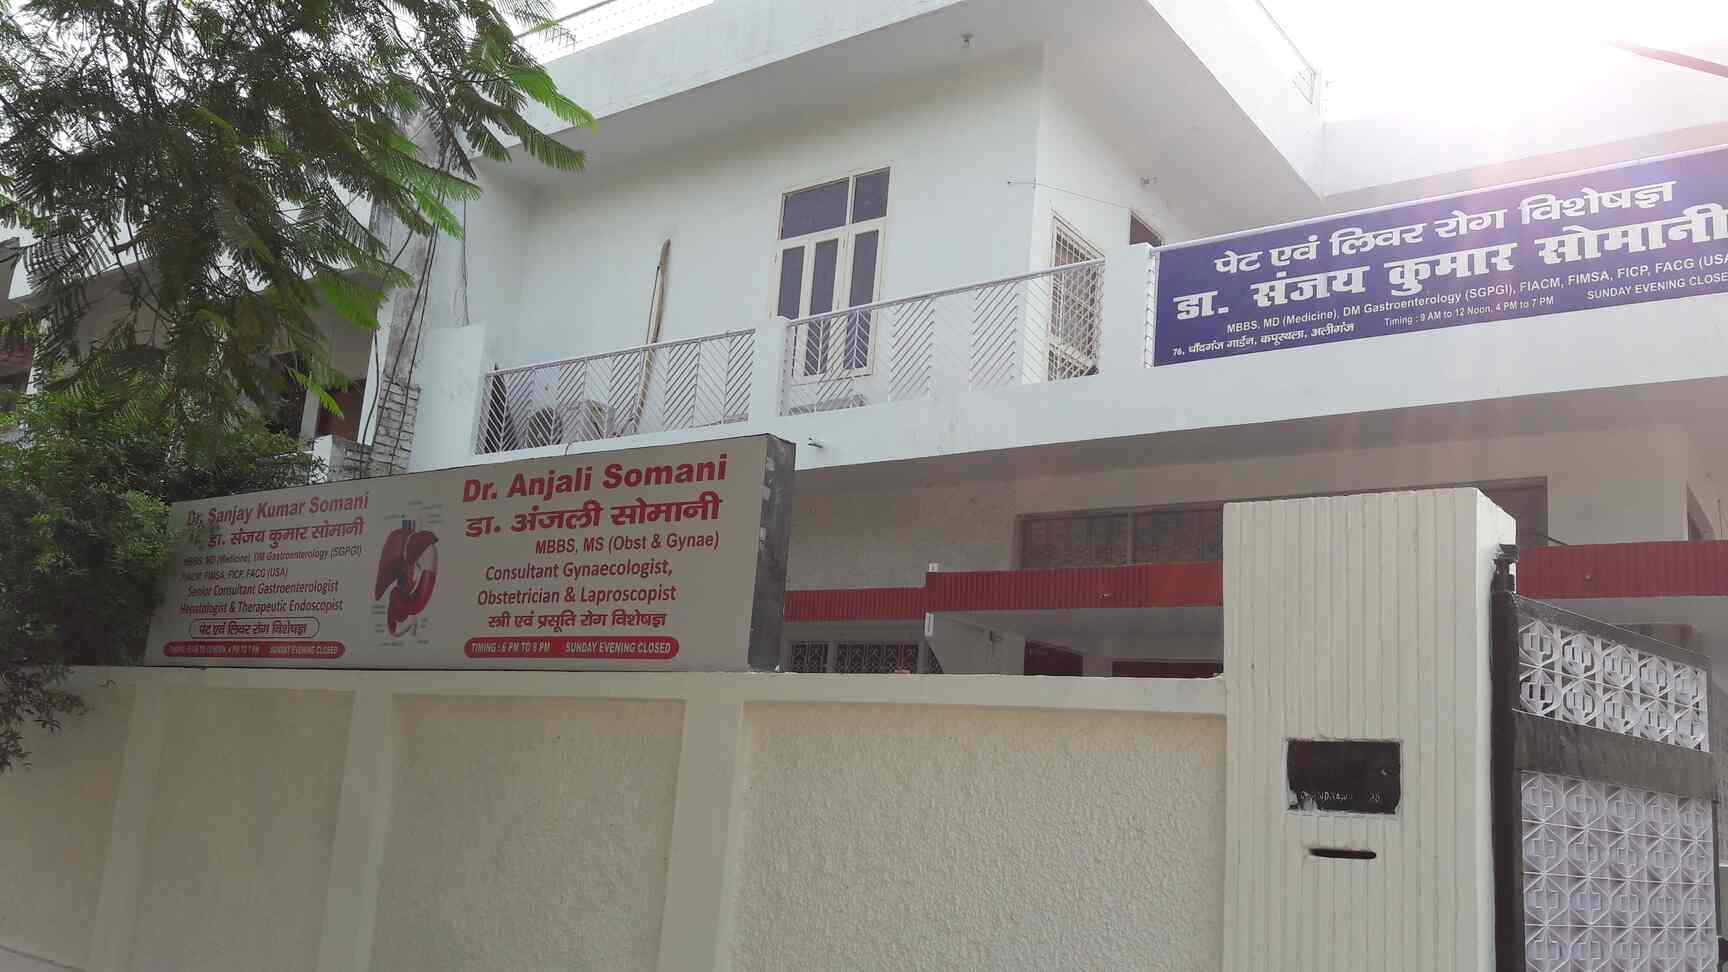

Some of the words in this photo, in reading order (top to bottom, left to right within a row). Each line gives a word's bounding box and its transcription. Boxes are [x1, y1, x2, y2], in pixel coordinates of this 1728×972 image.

[1214, 250, 1263, 274] पेट
[1269, 235, 1320, 266] एवं
[1329, 223, 1427, 257] लिवर
[1434, 209, 1508, 238] रोग
[1518, 181, 1677, 225] विशेषज्ञ
[1173, 290, 1229, 320] डा.
[1250, 265, 1370, 308] संजय
[1384, 243, 1518, 296] कुमार
[1534, 203, 1728, 264] सोमानी
[1263, 317, 1280, 329] MD
[1343, 306, 1361, 317] DM
[1364, 291, 1460, 313] Gastroenterology
[1465, 284, 1516, 301] (SGPGI),
[1519, 278, 1564, 292] FIACM,
[1568, 271, 1613, 285] FIMSA,
[1655, 258, 1694, 273] FACG
[1587, 286, 1632, 301] SUNDAY
[1635, 278, 1686, 294] EVENING
[1384, 315, 1413, 328] Timing
[1420, 311, 1425, 321] 9
[1426, 310, 1441, 321] AM
[1443, 310, 1453, 320] to
[1455, 308, 1465, 318] 12
[1495, 303, 1501, 312] 4
[1503, 301, 1517, 312] PM
[1520, 300, 1529, 309] to
[1531, 298, 1537, 308] 7
[1540, 296, 1554, 307] PM
[1311, 323, 1354, 338] अलीगंज
[462, 479, 497, 503] Dr.
[507, 466, 593, 501] Anjali
[602, 453, 728, 490] Somani
[207, 505, 253, 527] Sanjay
[256, 501, 304, 519] Kumar
[309, 493, 369, 514] Somani
[465, 516, 501, 538] डा.
[510, 500, 604, 533] अंजली
[610, 491, 723, 526] सोमानी
[230, 528, 265, 546] संजय
[269, 526, 308, 549] कुमार
[311, 516, 366, 538] सोमानी
[535, 537, 578, 555] MBBS,
[583, 536, 604, 551] MS
[608, 533, 648, 554] (Obst
[651, 533, 661, 549] &
[666, 530, 720, 552] Gynae)
[485, 561, 559, 581] Consultant
[563, 558, 673, 583] Gynaecologist,
[213, 581, 256, 597] Consultant
[258, 579, 338, 596] Gastroenterologist
[477, 588, 559, 606] Obstetrician
[564, 586, 576, 602] &
[580, 584, 677, 606] Laproscopist
[229, 603, 237, 613] &
[238, 600, 288, 616] Therapeutic
[289, 598, 344, 614] Endoscopist
[487, 611, 510, 629] स्त्री
[514, 609, 534, 628] एवं
[537, 609, 577, 633] प्रसूति
[580, 611, 609, 627] रोग
[611, 608, 667, 628] विशेषज्ञ
[471, 642, 497, 653] TIMING
[507, 642, 520, 653] PM
[521, 642, 532, 653] TO
[538, 642, 551, 653] PM
[565, 642, 598, 653] SUNDAY
[599, 642, 635, 654] EVENING
[636, 642, 671, 654] CLOSED
